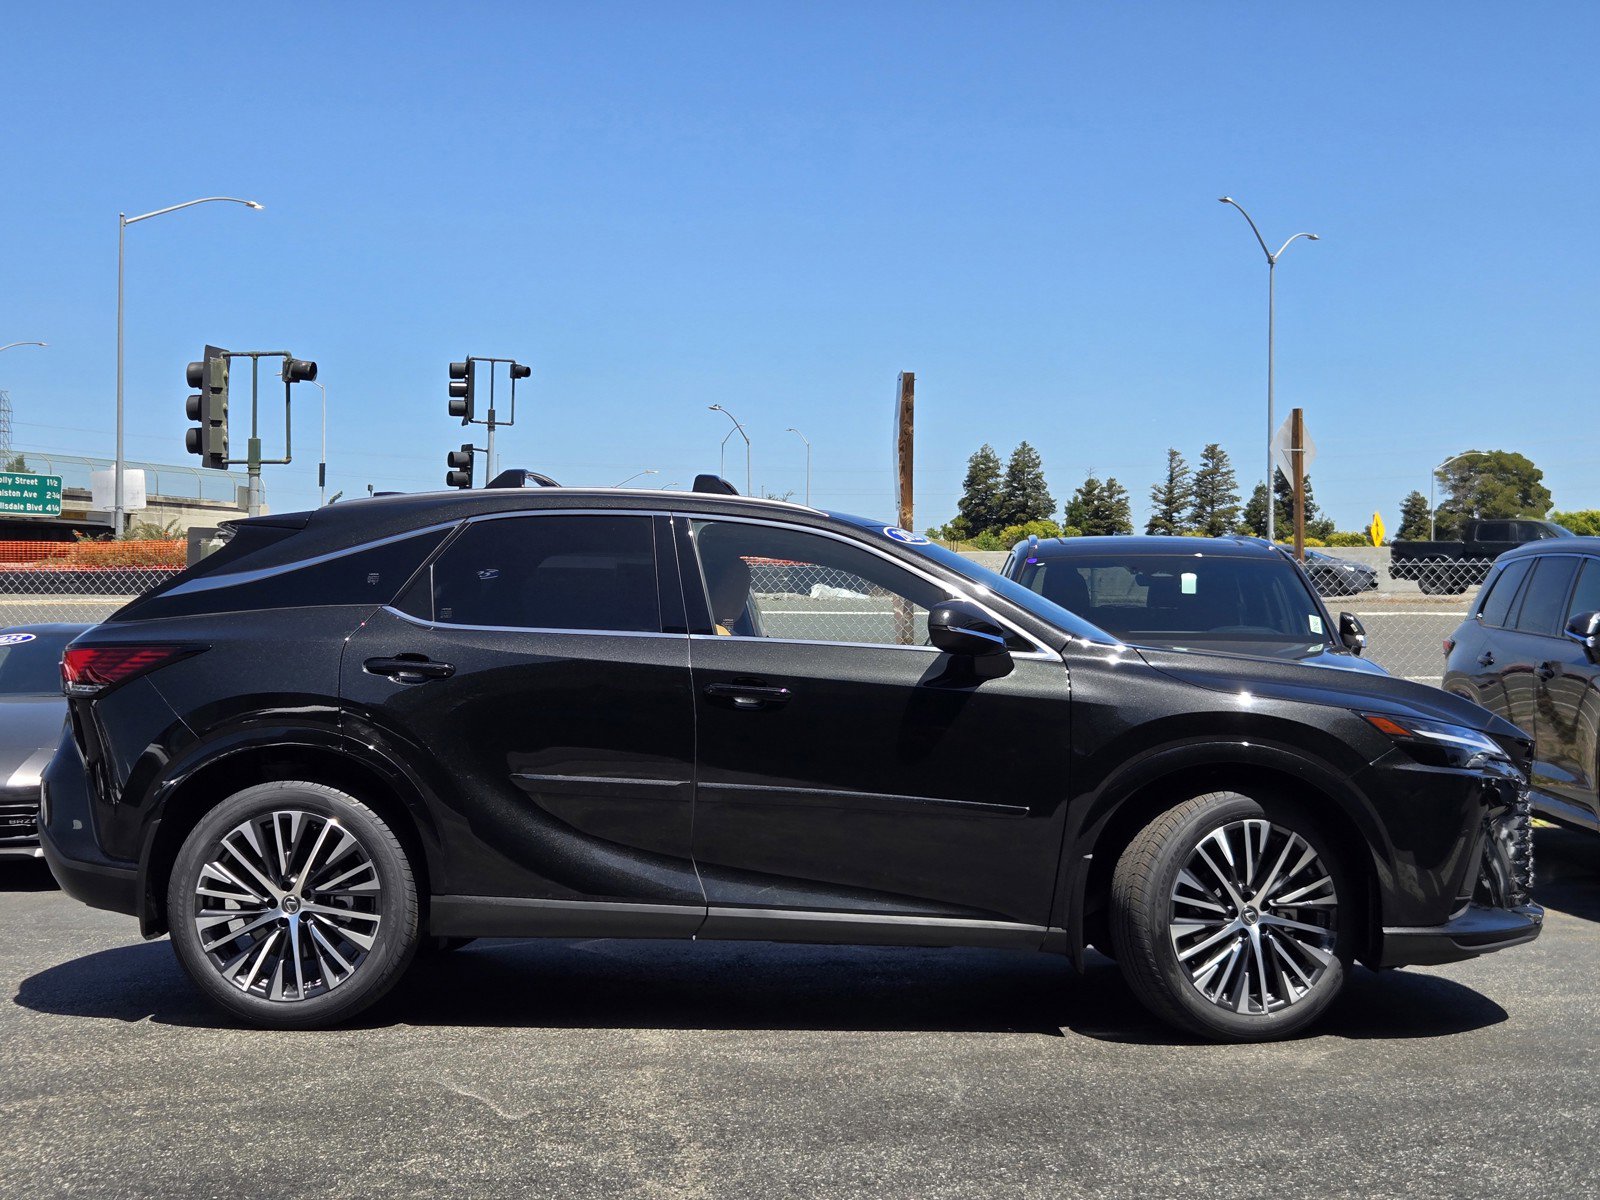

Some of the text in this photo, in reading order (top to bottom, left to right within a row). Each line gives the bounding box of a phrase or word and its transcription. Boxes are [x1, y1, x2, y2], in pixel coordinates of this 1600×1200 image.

[15, 477, 38, 485] Street
[23, 490, 38, 498] Ave
[26, 503, 43, 511] Blvd
